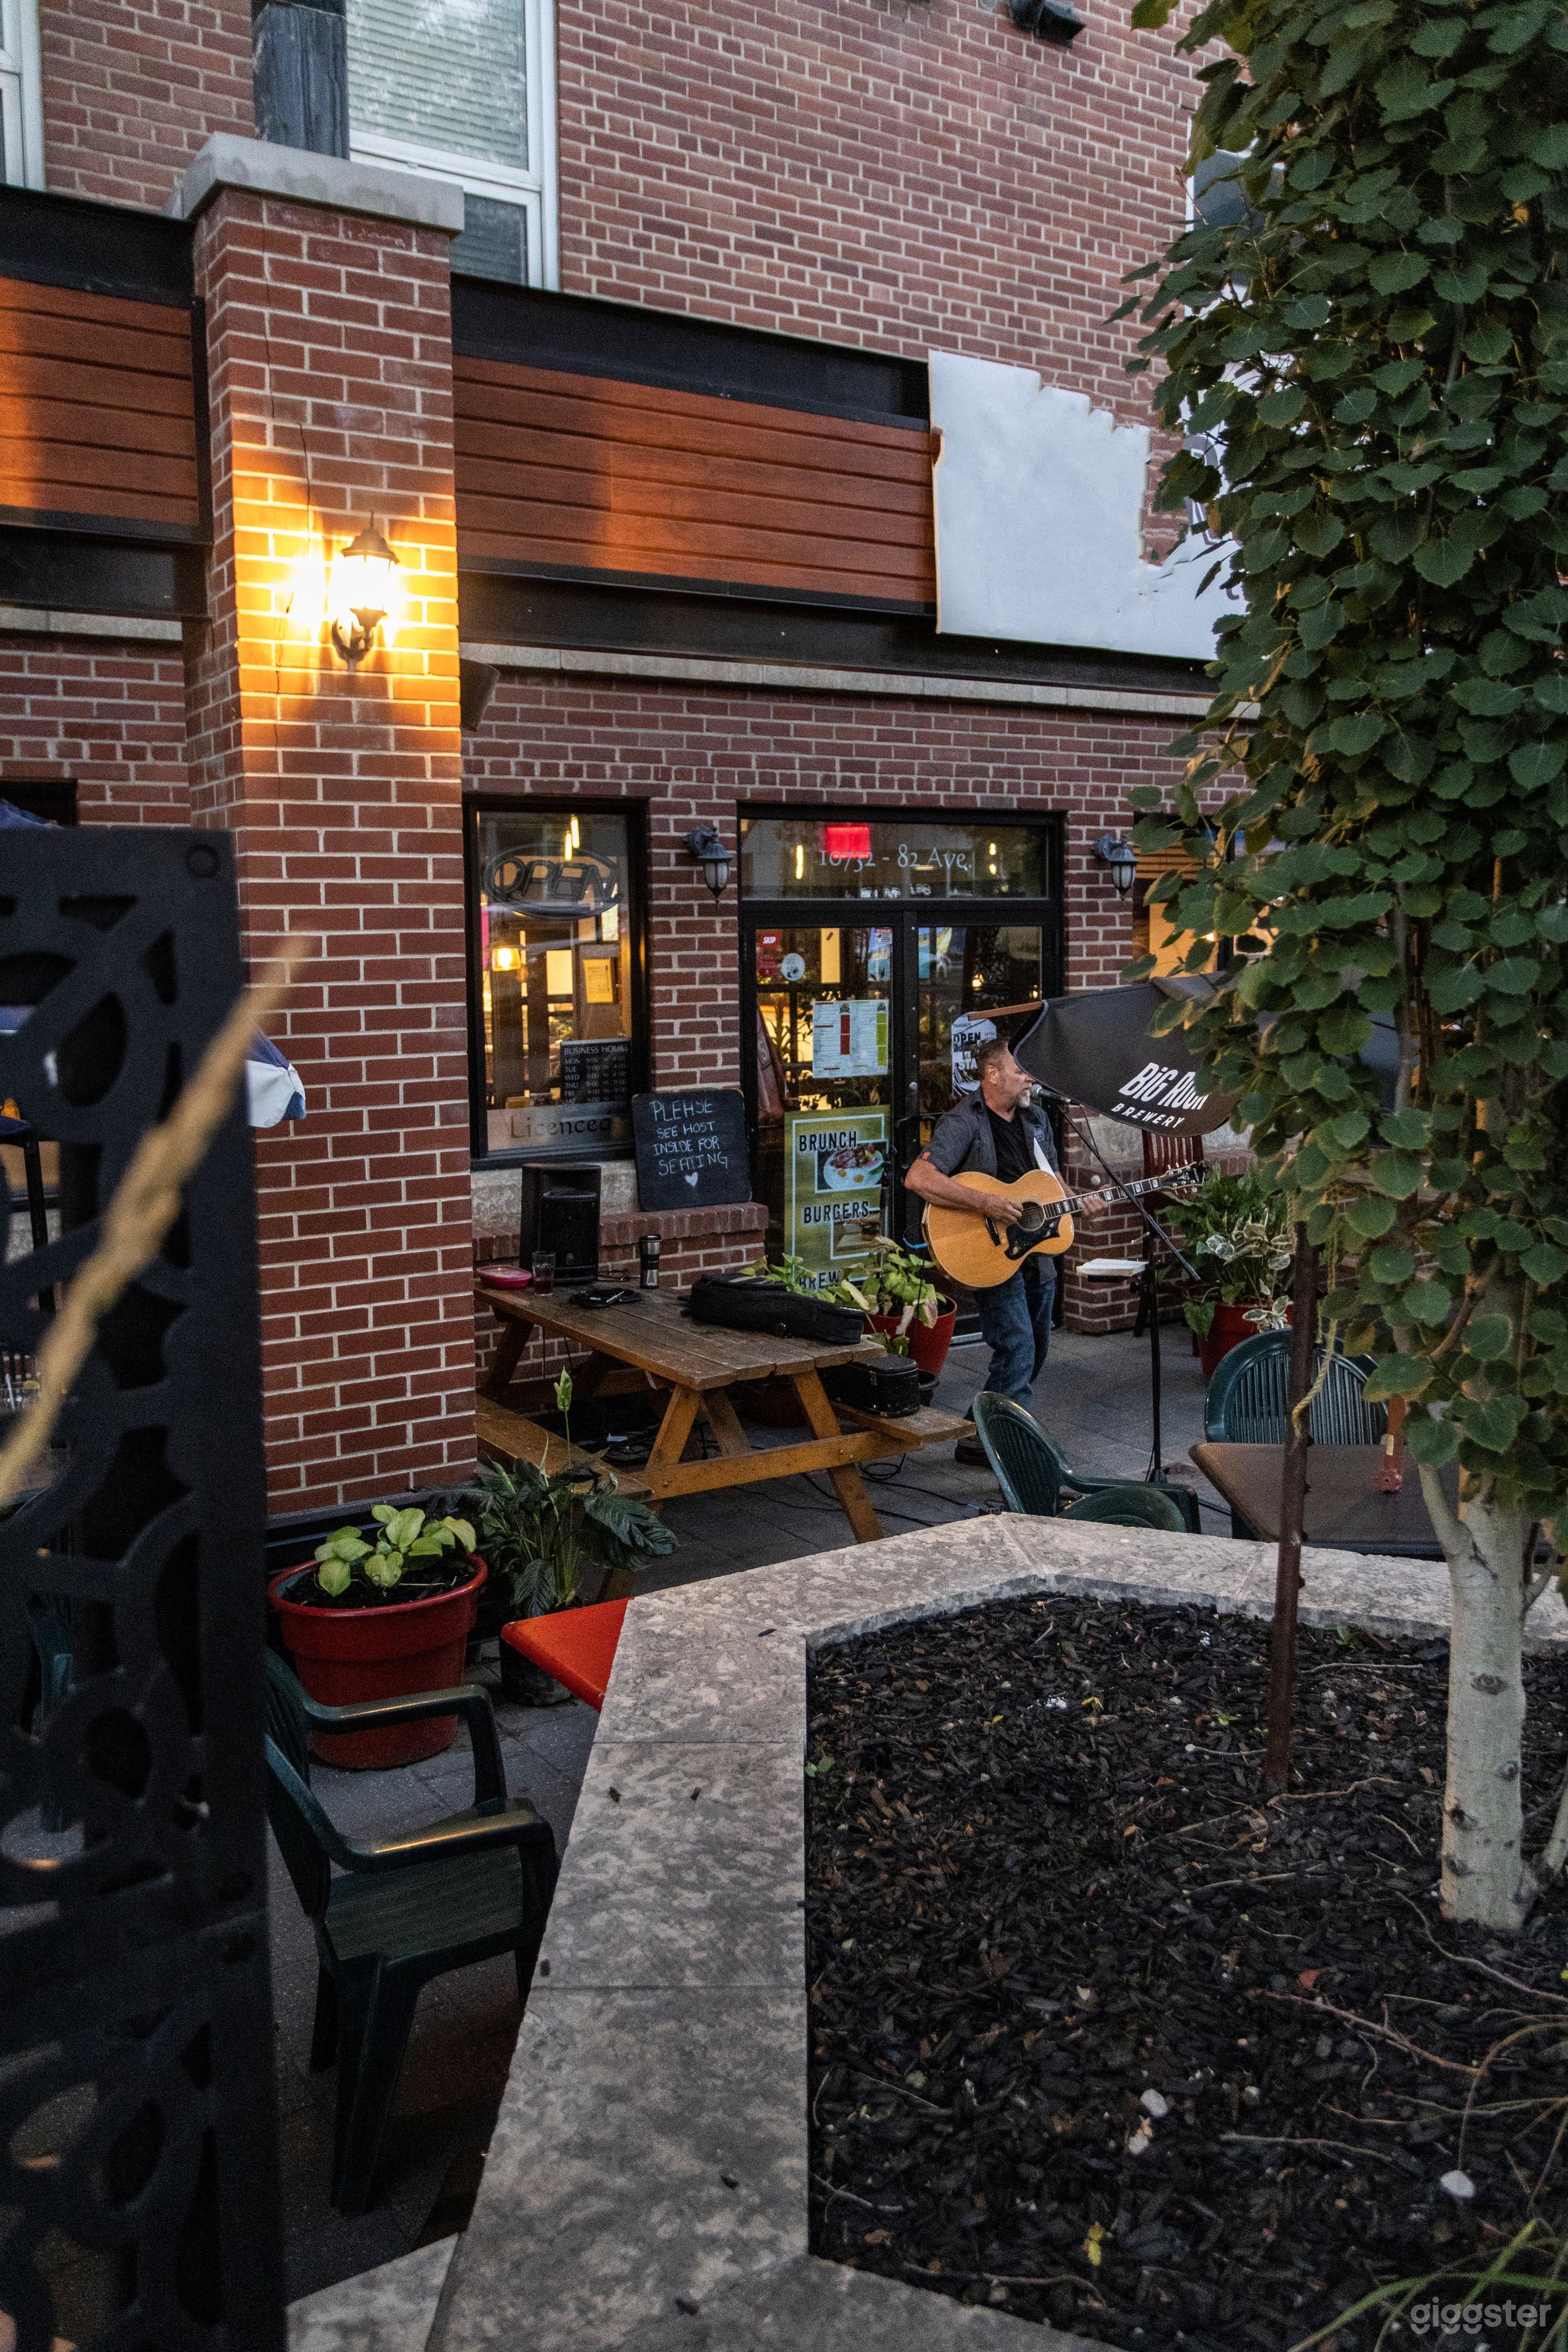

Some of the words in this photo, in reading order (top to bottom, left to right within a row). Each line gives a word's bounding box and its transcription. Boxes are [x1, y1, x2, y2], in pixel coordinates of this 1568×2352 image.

[819, 850, 876, 872] 10732
[897, 844, 920, 867] 82
[489, 856, 622, 902] OPEN
[953, 1032, 981, 1043] OPEN
[564, 1046, 599, 1055] BUSINESS
[601, 1045, 628, 1053] HOURS
[650, 1099, 713, 1122] PLEASE
[1111, 1103, 1185, 1128] BREWERY
[511, 1111, 611, 1138] Licenced
[657, 1125, 678, 1139] SEE
[683, 1120, 715, 1135] HOST
[653, 1139, 694, 1156] INSIDE
[698, 1136, 720, 1152] FOR
[799, 1131, 857, 1152] BRUNCH
[658, 1152, 728, 1177] SEATING
[804, 1200, 869, 1224] BURGERS
